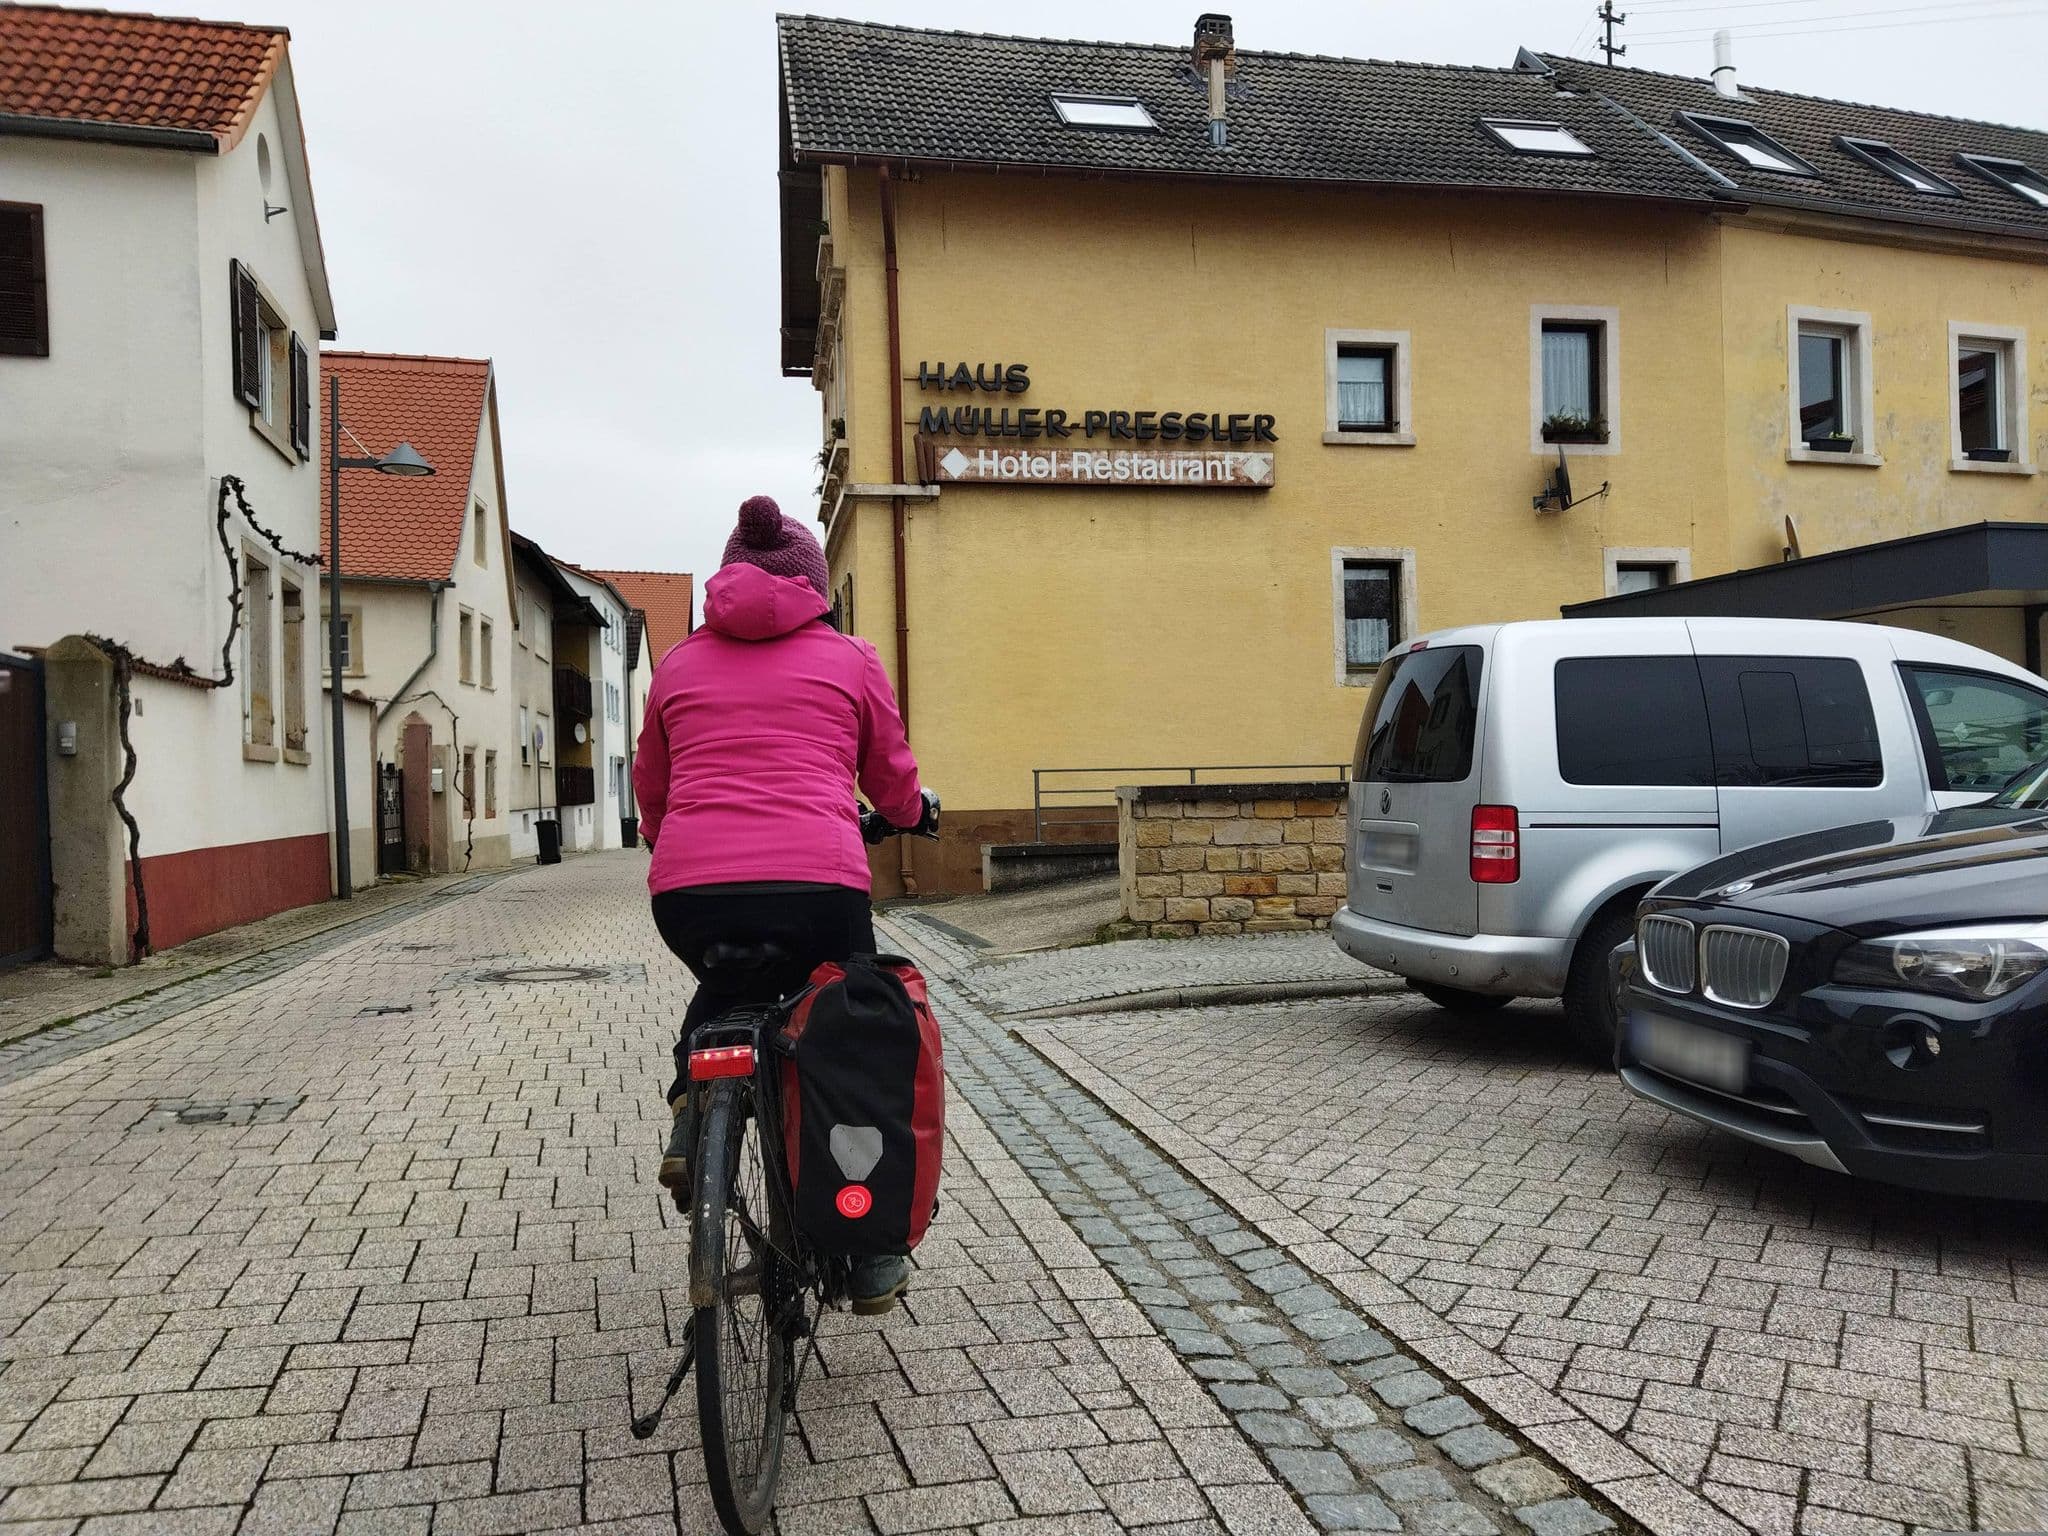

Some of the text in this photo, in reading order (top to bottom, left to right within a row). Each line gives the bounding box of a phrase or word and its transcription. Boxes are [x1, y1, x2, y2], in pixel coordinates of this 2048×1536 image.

[919, 361, 1031, 393] HAUS
[919, 405, 1279, 442] MÜLLER-PRESSLER
[978, 449, 1234, 481] Hotel-Restaurant
